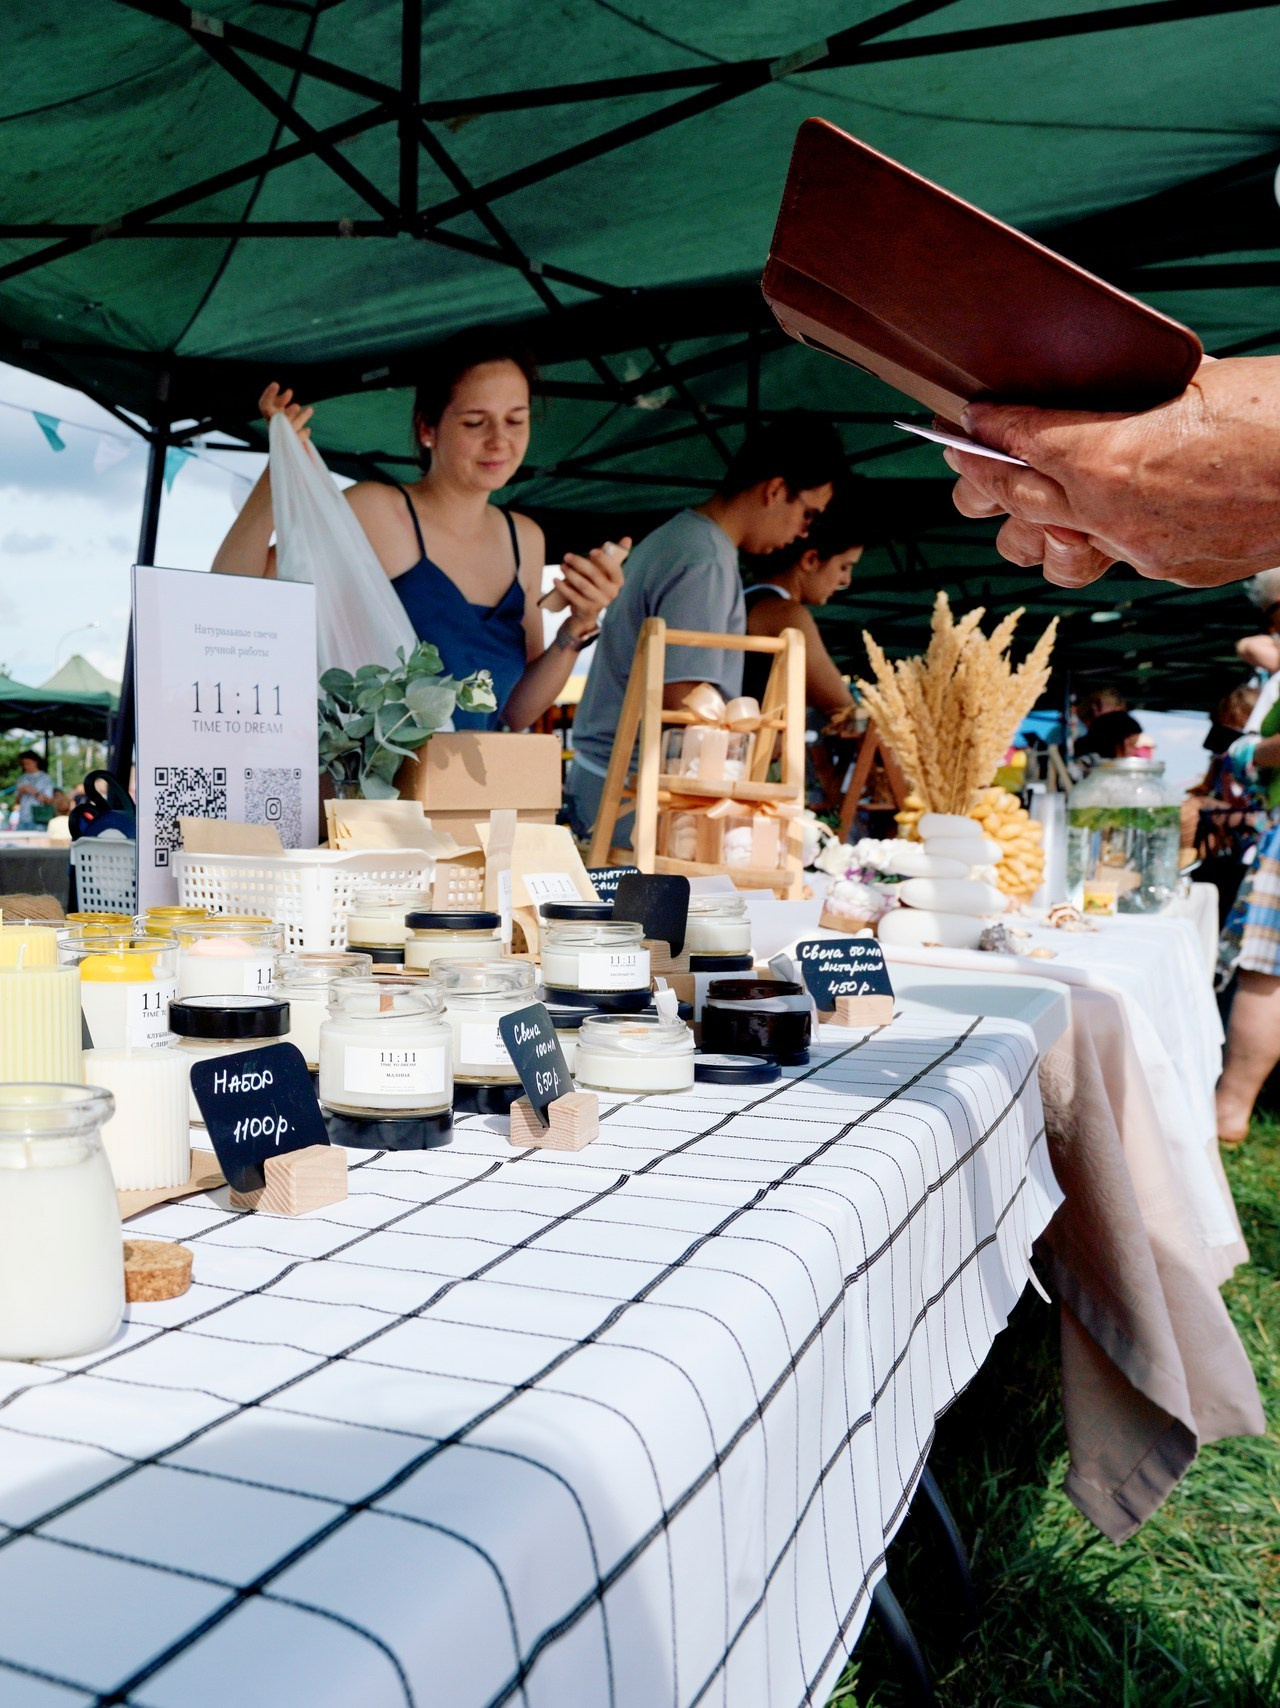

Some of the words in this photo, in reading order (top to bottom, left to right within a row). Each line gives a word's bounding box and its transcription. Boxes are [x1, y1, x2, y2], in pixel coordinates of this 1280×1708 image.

[194, 624, 251, 638] Натуральные
[253, 631, 278, 639] свечи
[205, 646, 235, 656] ручной
[238, 646, 269, 657] работы
[192, 681, 282, 715] 11:11
[193, 720, 221, 733] TIME
[225, 721, 241, 733] TO
[245, 722, 283, 734] DREAM
[532, 880, 575, 894] 11:11
[802, 944, 844, 960] Свеча
[611, 955, 636, 964] 11:11
[819, 960, 883, 977] янтарная
[514, 1022, 541, 1045] Свеча
[380, 1052, 416, 1062] 11:11
